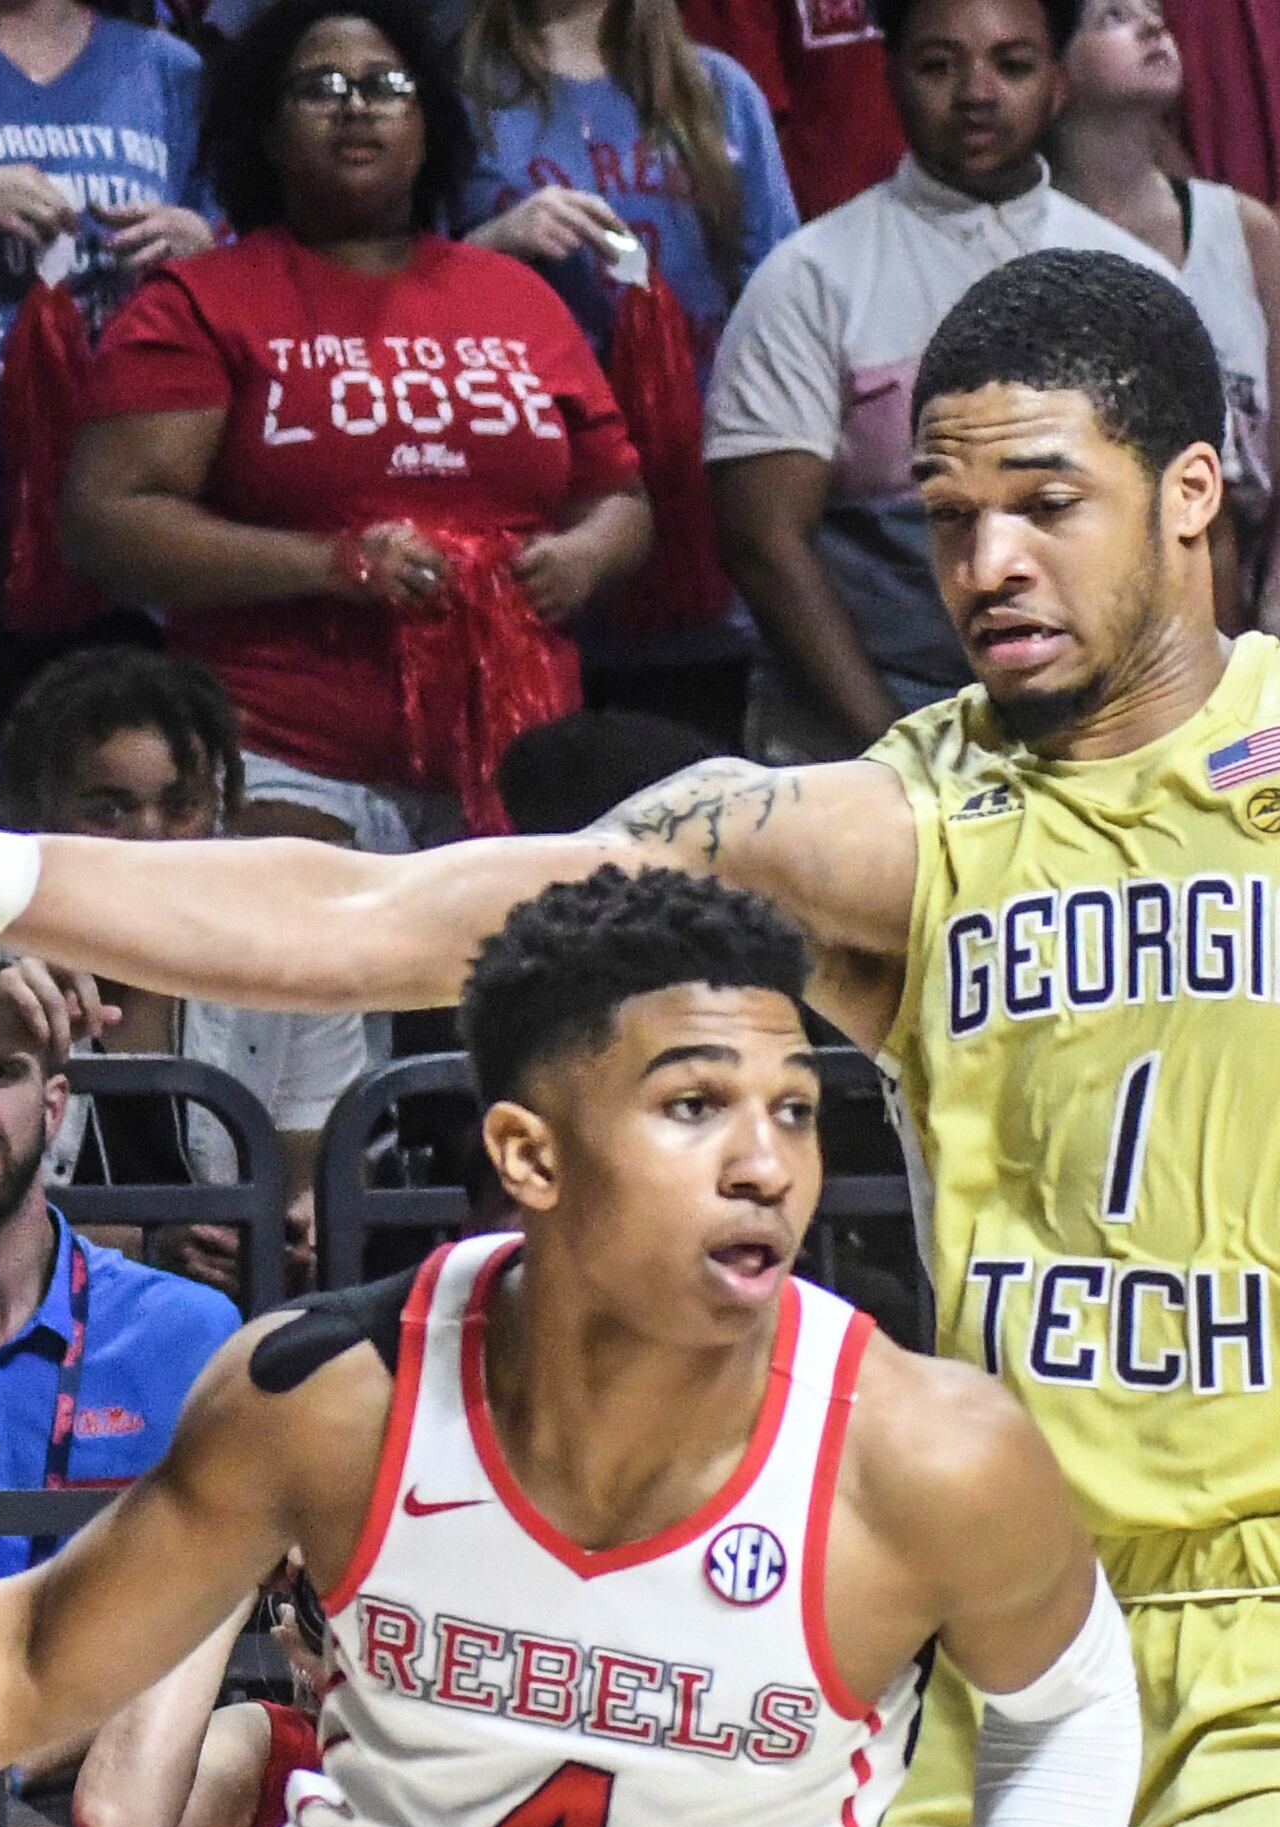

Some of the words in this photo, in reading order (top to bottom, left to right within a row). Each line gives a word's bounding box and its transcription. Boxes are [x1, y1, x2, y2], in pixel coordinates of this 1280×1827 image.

[263, 368, 562, 446] LOOSE
[269, 334, 371, 372] TIME
[383, 336, 446, 370] TO
[454, 336, 529, 372] GET
[1102, 1050, 1162, 1224] 1
[965, 1256, 1271, 1395] TECH
[708, 1526, 784, 1604] SEC
[357, 1593, 821, 1765] REBELS
